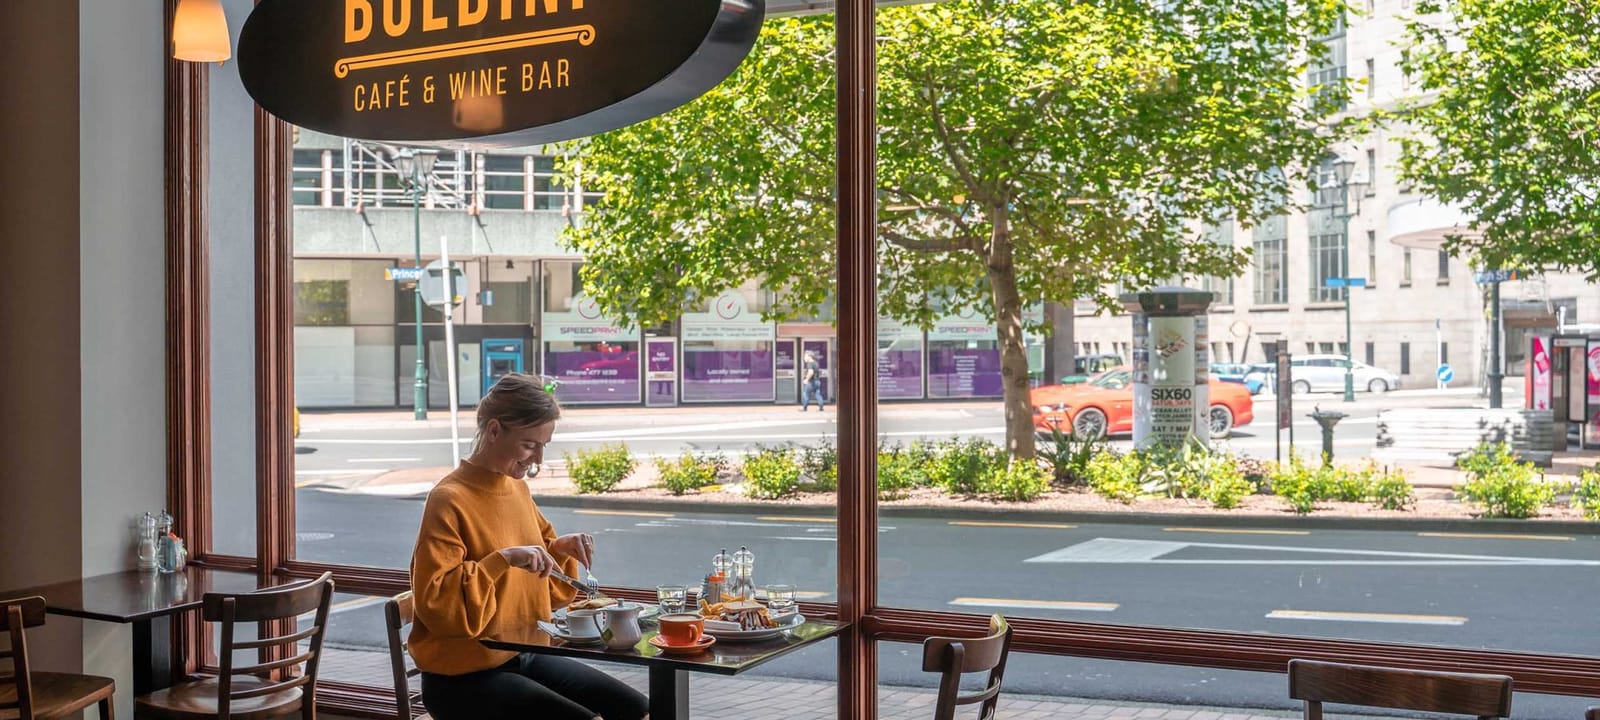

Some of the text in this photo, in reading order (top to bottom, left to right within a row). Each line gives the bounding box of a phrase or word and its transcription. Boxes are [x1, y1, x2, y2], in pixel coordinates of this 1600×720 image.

[354, 59, 570, 111] CAFÉ & WINE BAR
[1151, 388, 1191, 400] SIX60
